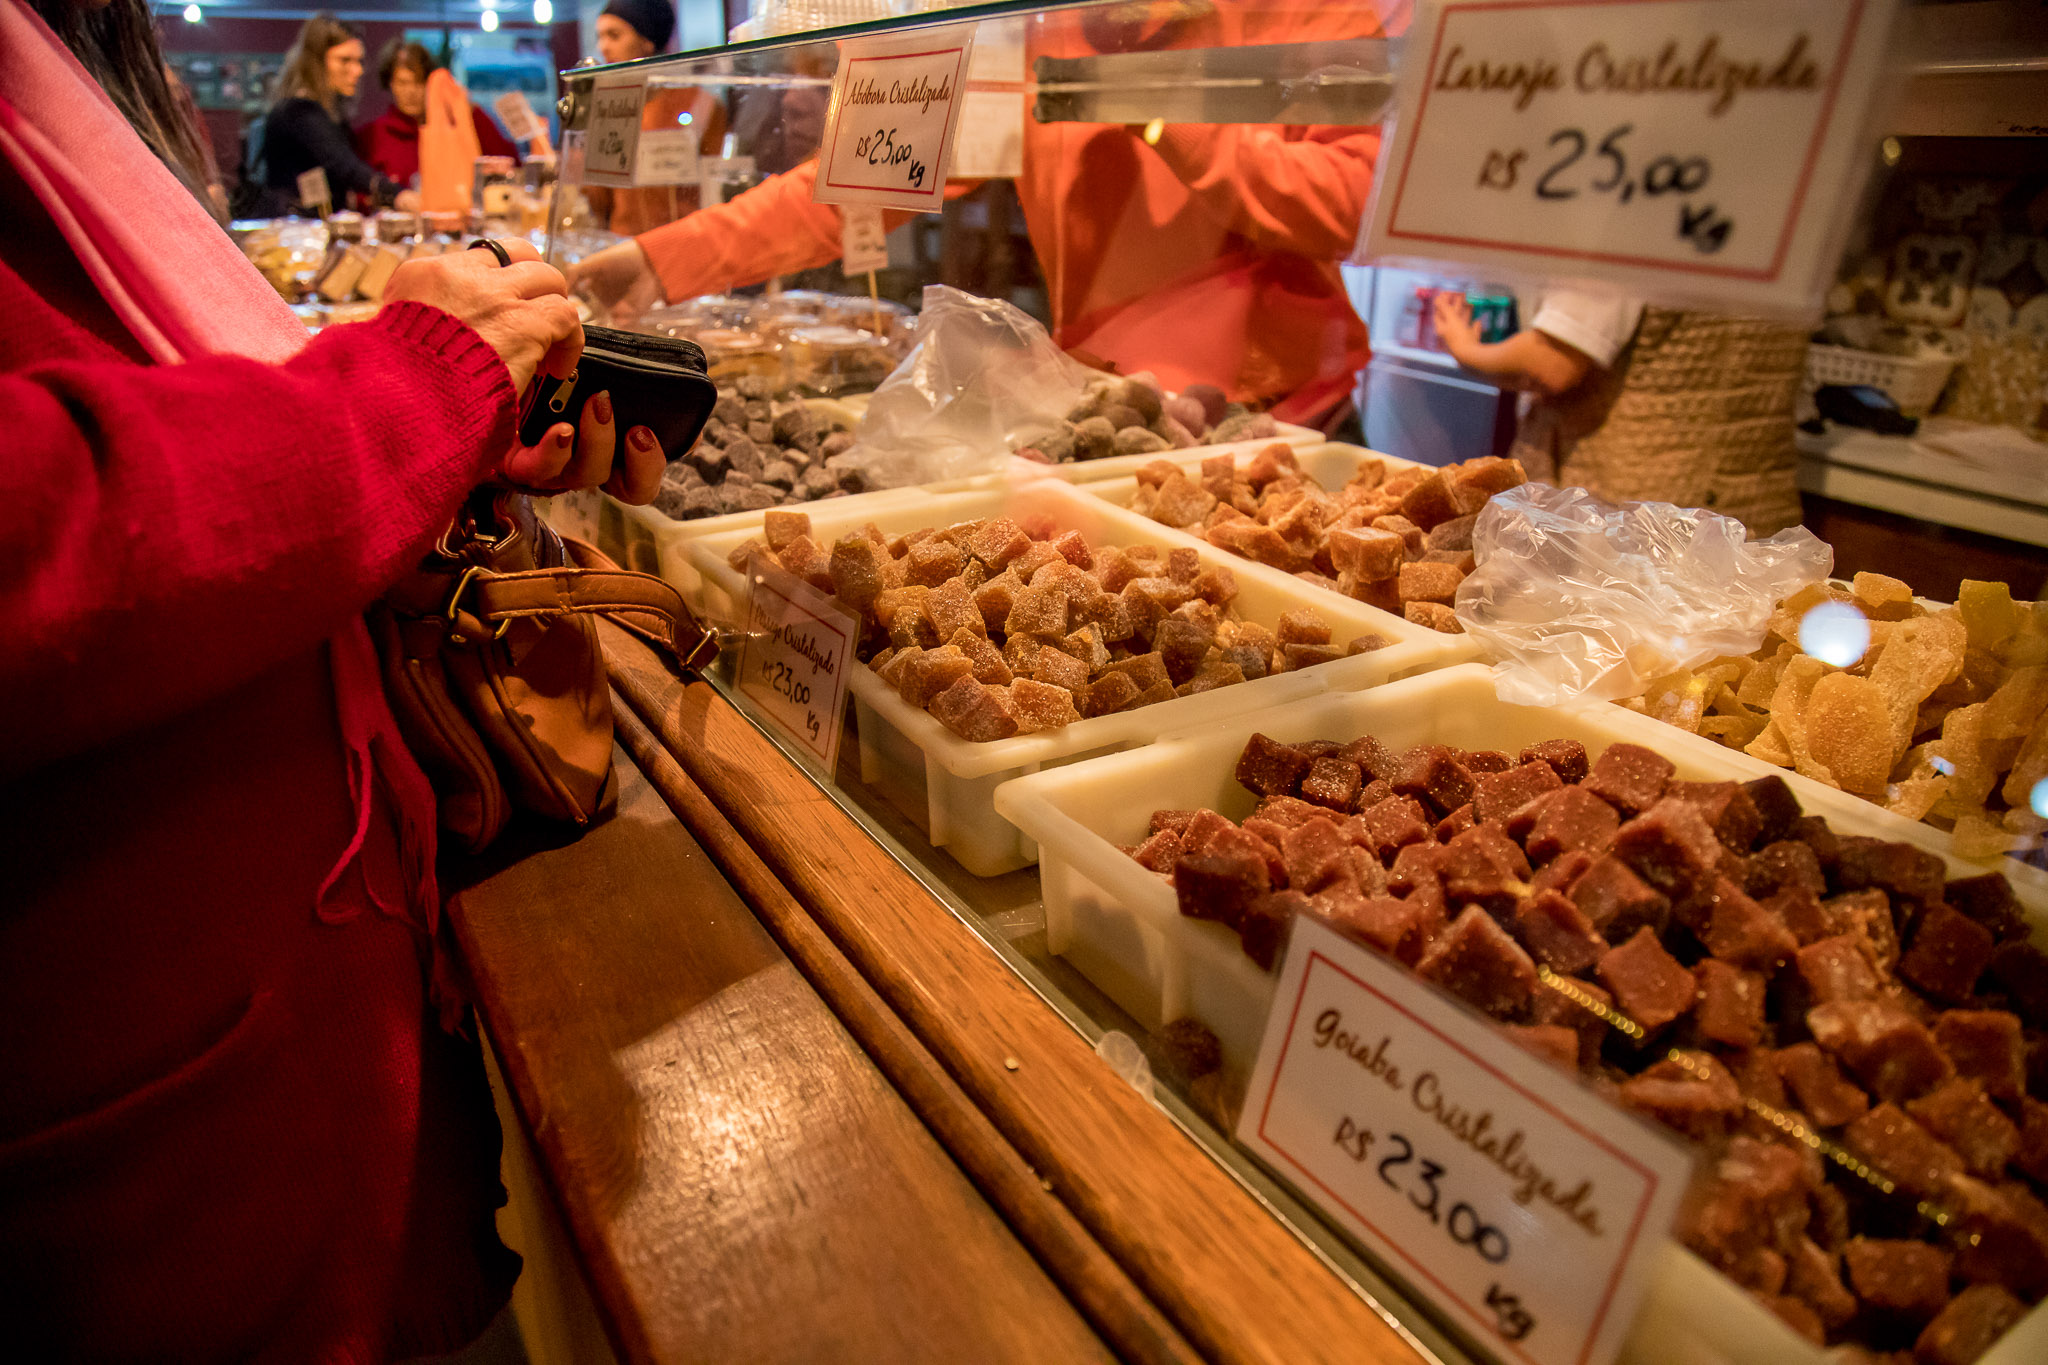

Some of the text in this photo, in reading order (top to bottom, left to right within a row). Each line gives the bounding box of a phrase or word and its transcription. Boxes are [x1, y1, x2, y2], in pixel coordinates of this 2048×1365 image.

[846, 75, 950, 114] Abóbora Cristalizada
[1435, 34, 1820, 117] Laranja Cristalizada
[868, 128, 912, 166] 25,00
[1535, 124, 1711, 204] 25,00
[784, 623, 834, 675] Cristalizado
[773, 661, 810, 705] 23,00
[1412, 1070, 1602, 1237] Cristalizada
[1378, 1133, 1509, 1264] 23,00
